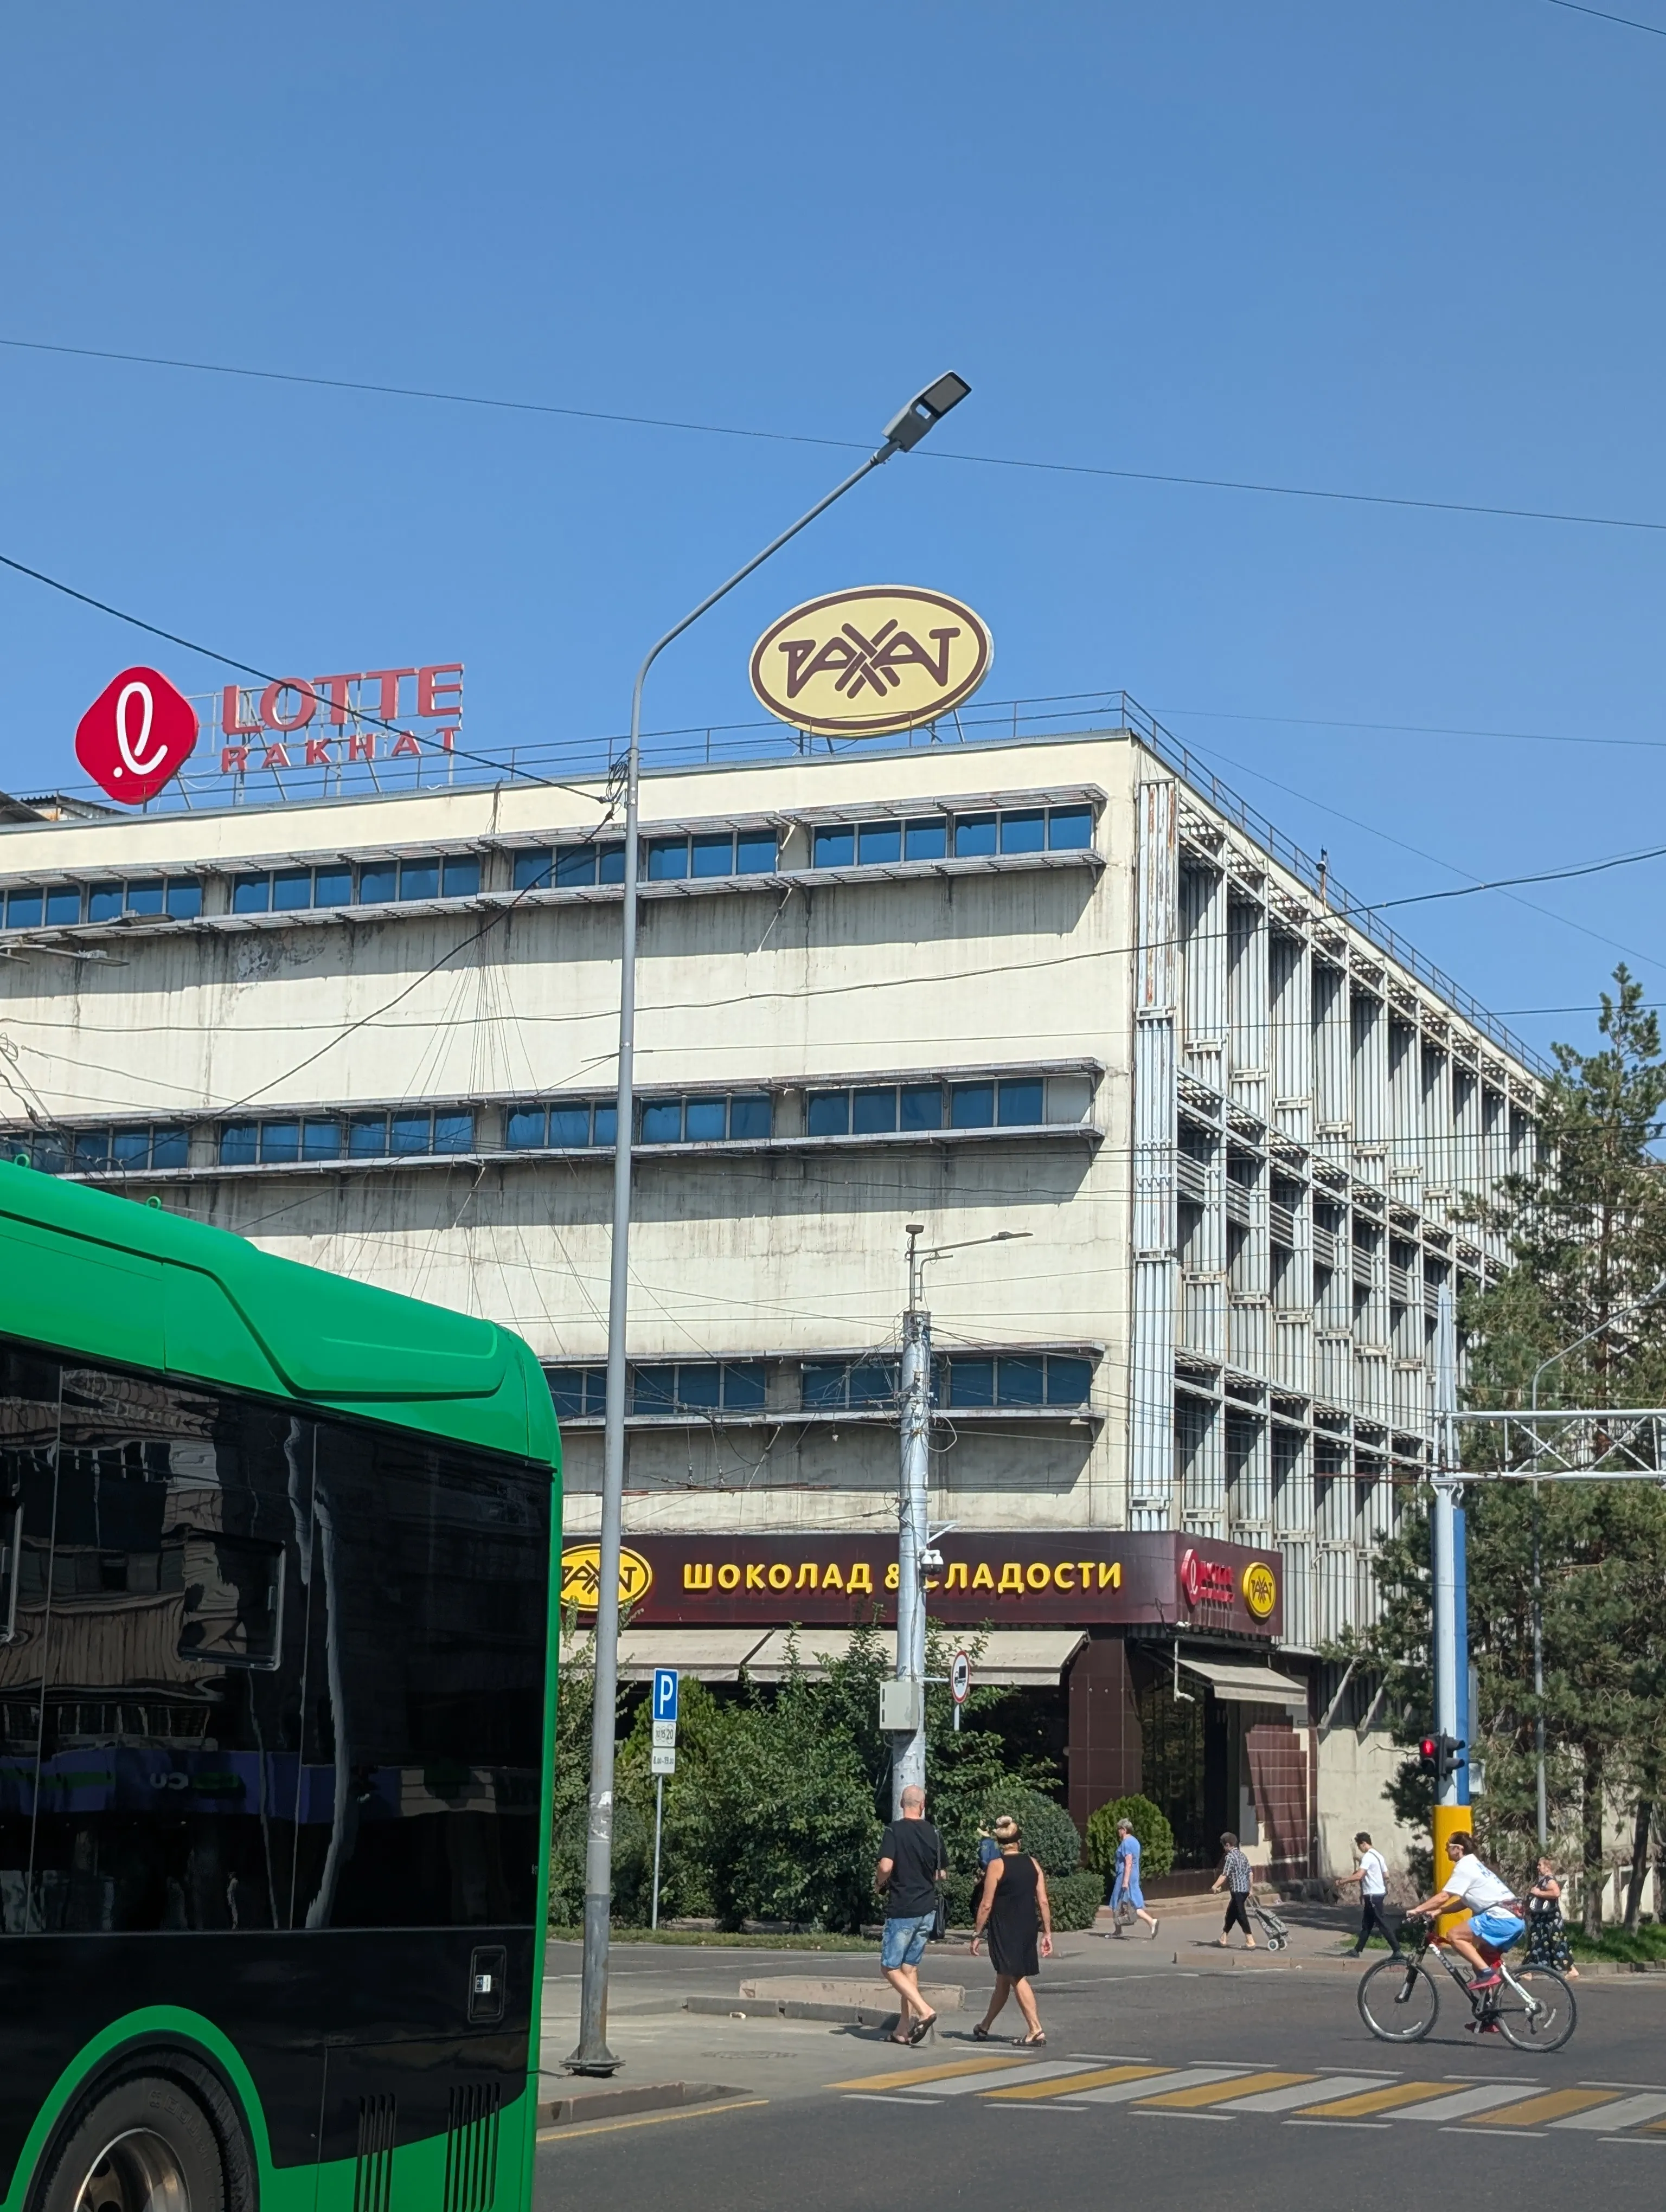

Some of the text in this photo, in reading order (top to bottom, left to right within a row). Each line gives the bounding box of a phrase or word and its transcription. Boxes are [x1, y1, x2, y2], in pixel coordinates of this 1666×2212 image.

[779, 619, 960, 699] РАХАТ
[222, 664, 464, 735] LOTTE
[222, 727, 462, 773] RAKHAT
[683, 1563, 873, 1594] ШОКОЛАД
[659, 1674, 674, 1715] P
[667, 1728, 674, 1740] 20
